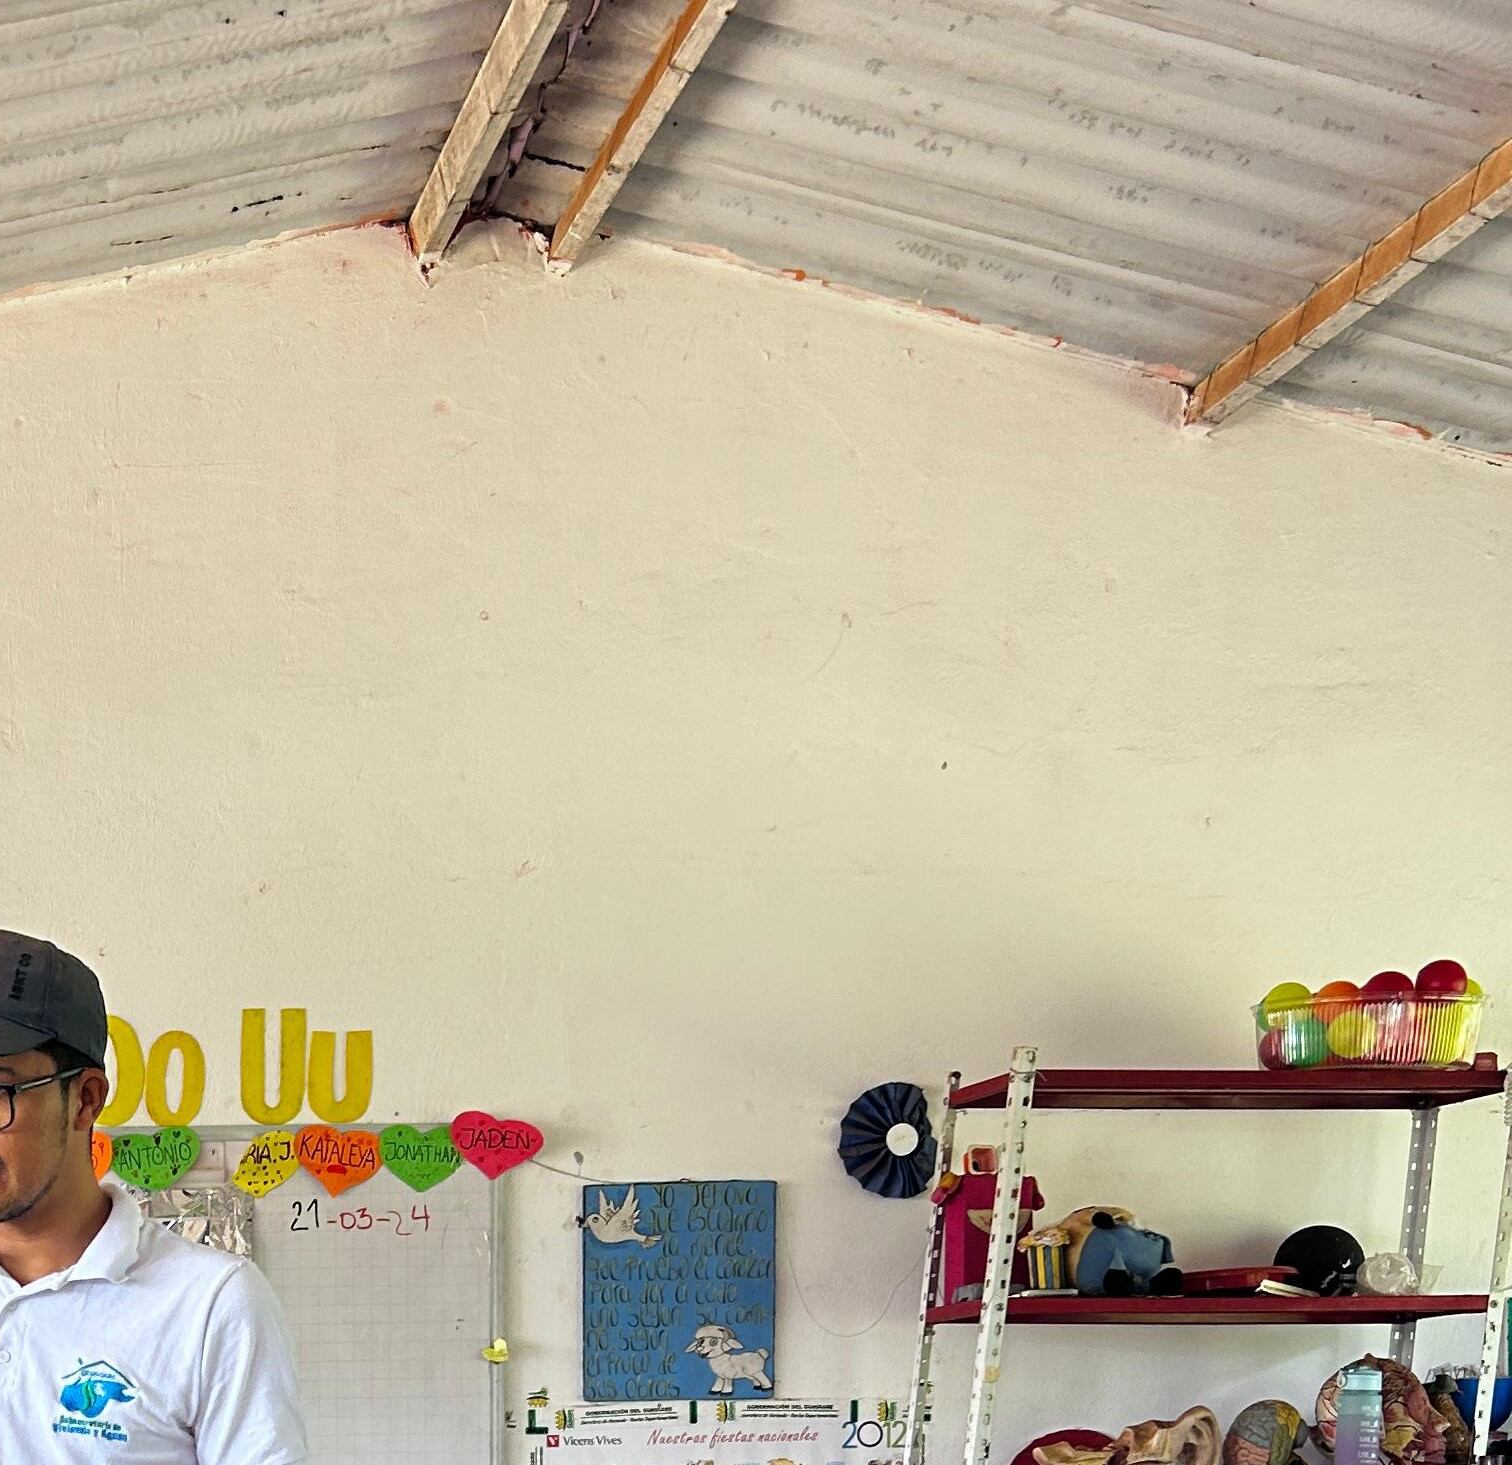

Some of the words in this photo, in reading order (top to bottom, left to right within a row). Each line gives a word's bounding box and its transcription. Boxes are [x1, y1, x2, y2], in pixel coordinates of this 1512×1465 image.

[241, 1008, 373, 1126] Uu
[118, 1141, 192, 1172] ANTONIO
[299, 1134, 376, 1171] KATALEYA
[384, 1142, 462, 1165] JONATHAN
[595, 1435, 622, 1446] Vives
[647, 1428, 706, 1446] Nuestras
[709, 1427, 754, 1449] fiestas
[757, 1426, 819, 1443] nacionales
